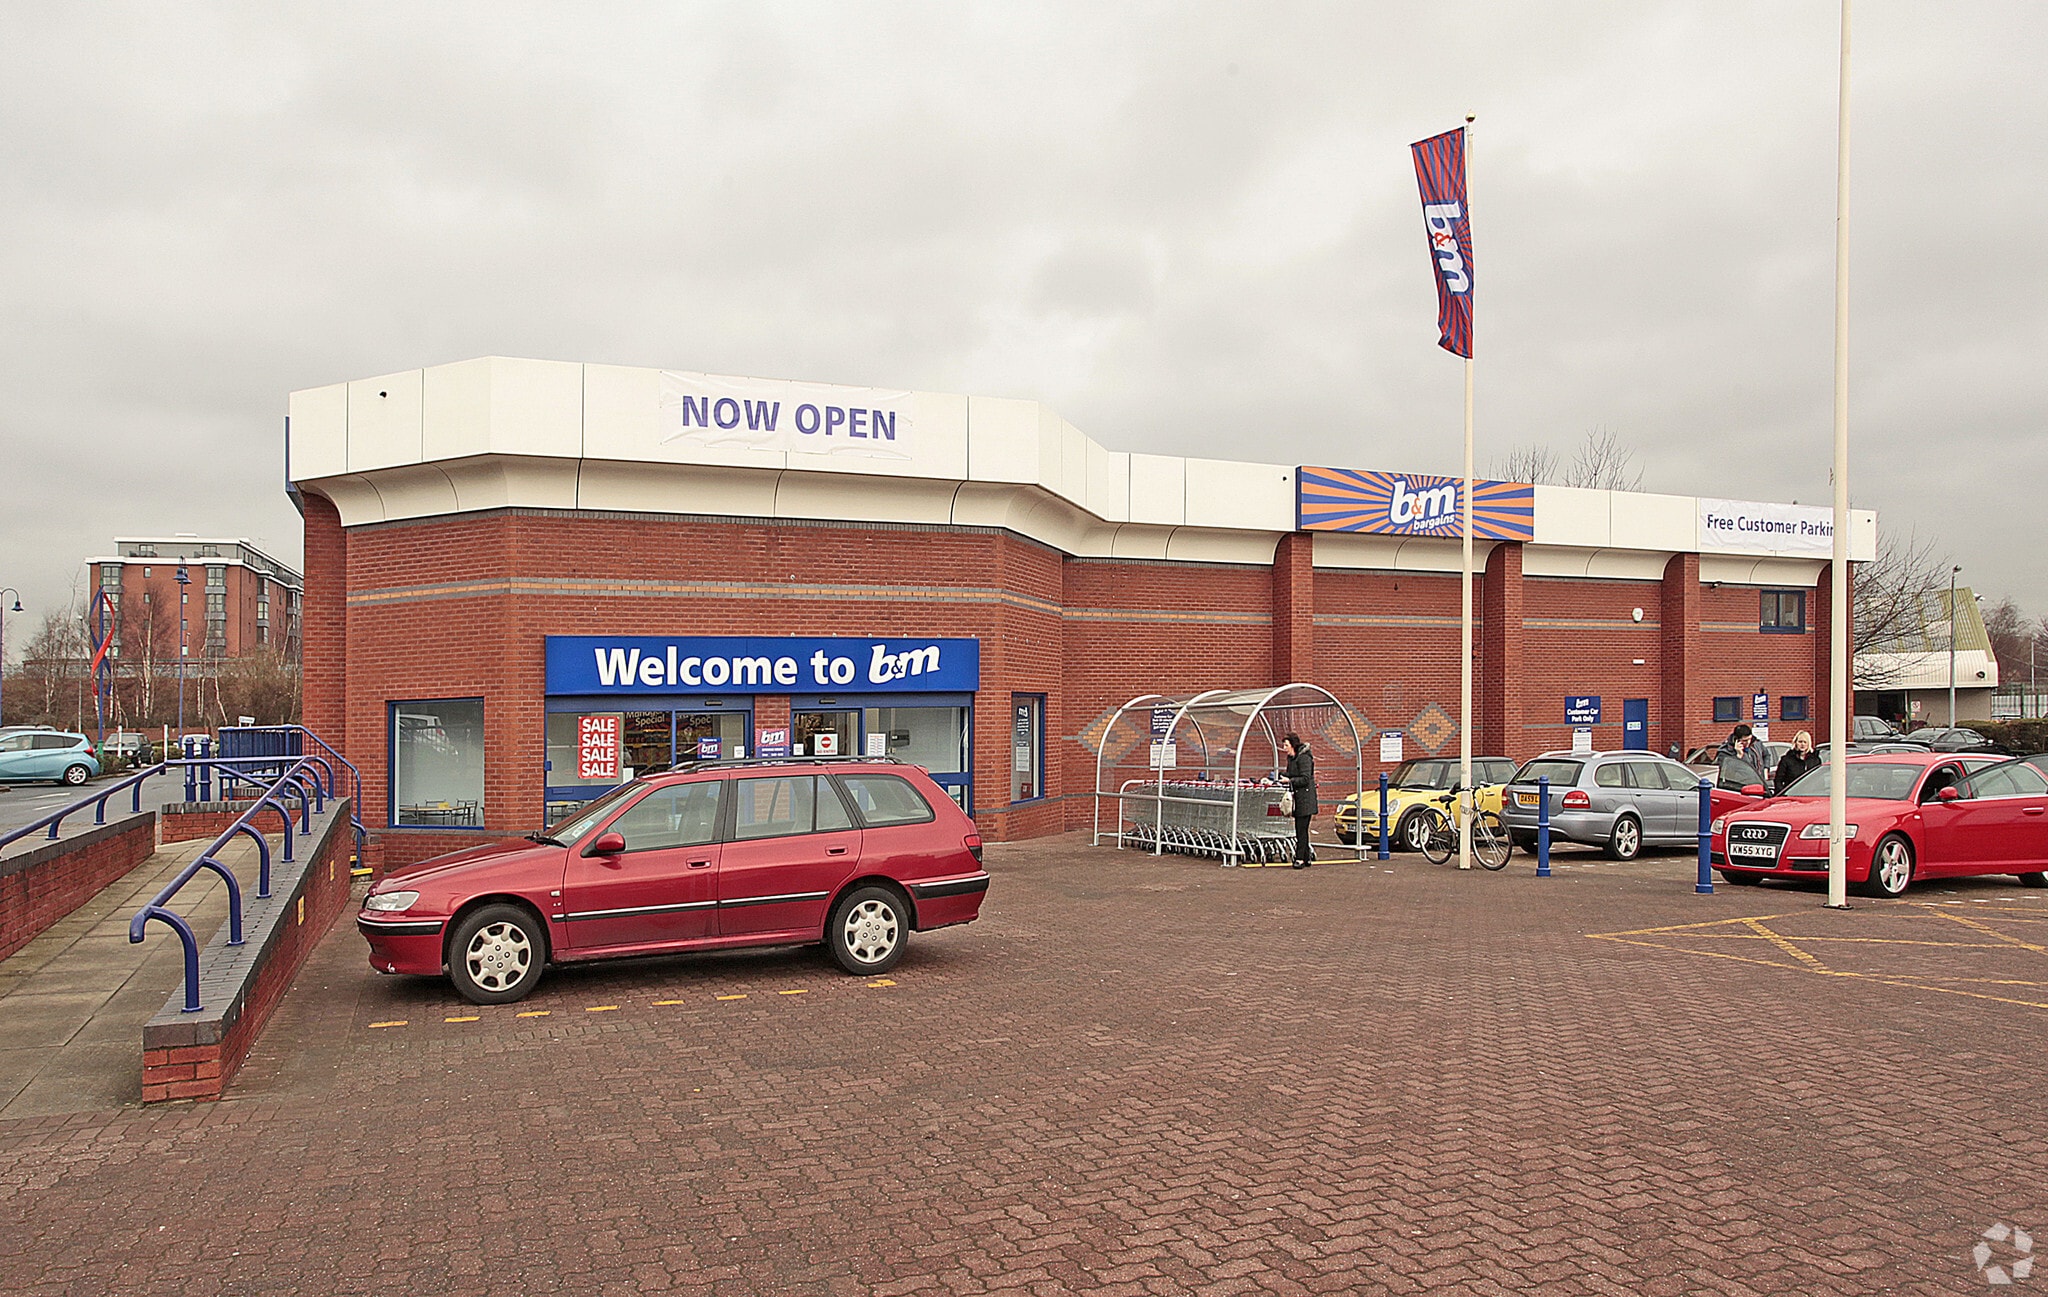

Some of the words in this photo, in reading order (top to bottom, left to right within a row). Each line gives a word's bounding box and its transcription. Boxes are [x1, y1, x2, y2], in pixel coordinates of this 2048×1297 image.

[1425, 200, 1469, 295] b&m
[682, 395, 780, 432] NOW
[795, 403, 896, 441] OPEN
[1390, 481, 1456, 524] b&m
[1413, 514, 1455, 531] bargains
[1707, 514, 1734, 530] Free
[1737, 516, 1797, 535] Customer
[1800, 520, 1834, 537] Parki
[594, 646, 797, 686] Welcome
[810, 650, 856, 685] to
[868, 644, 941, 684] b&m
[582, 718, 615, 733] SALE
[635, 714, 665, 727] Special
[689, 715, 712, 727] Spec
[581, 733, 615, 747] SALE
[581, 748, 615, 762] SALE
[581, 762, 615, 777] SALE
[1755, 846, 1773, 857] XYG
